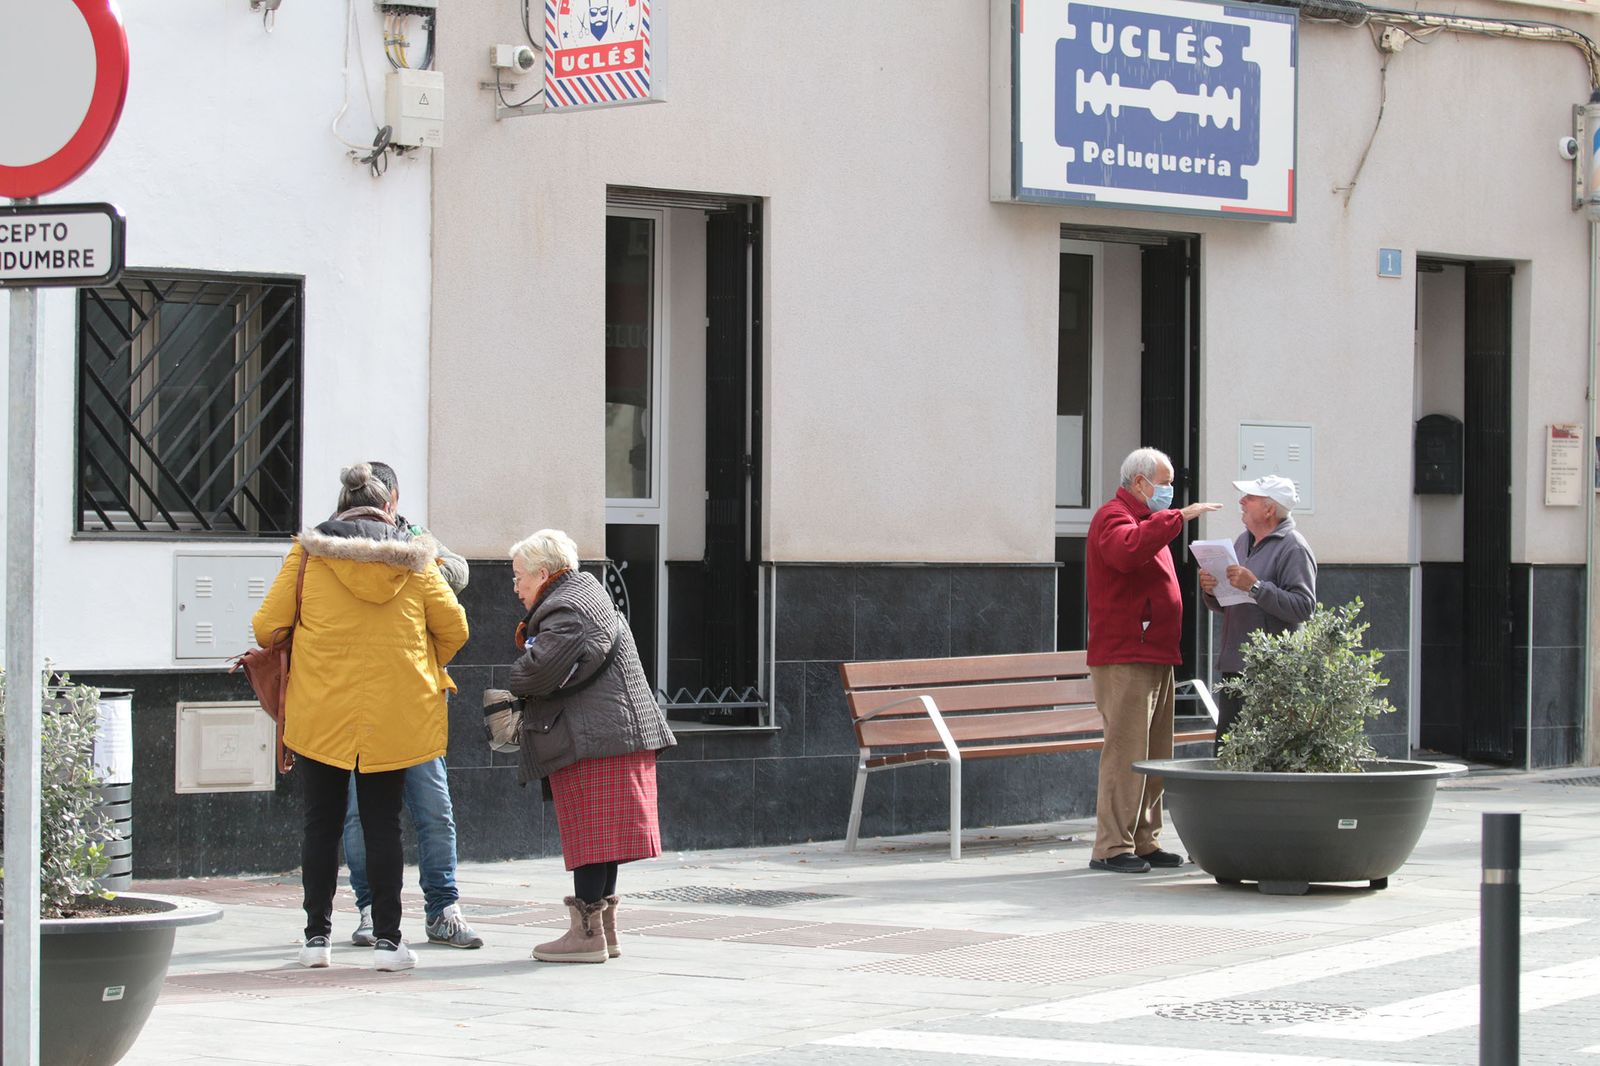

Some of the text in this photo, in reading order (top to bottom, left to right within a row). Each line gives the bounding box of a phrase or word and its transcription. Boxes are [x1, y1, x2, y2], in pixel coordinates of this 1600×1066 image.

[561, 46, 637, 72] UCLÉS
[1090, 21, 1225, 68] UCLÉS
[1083, 140, 1232, 177] Peluquería
